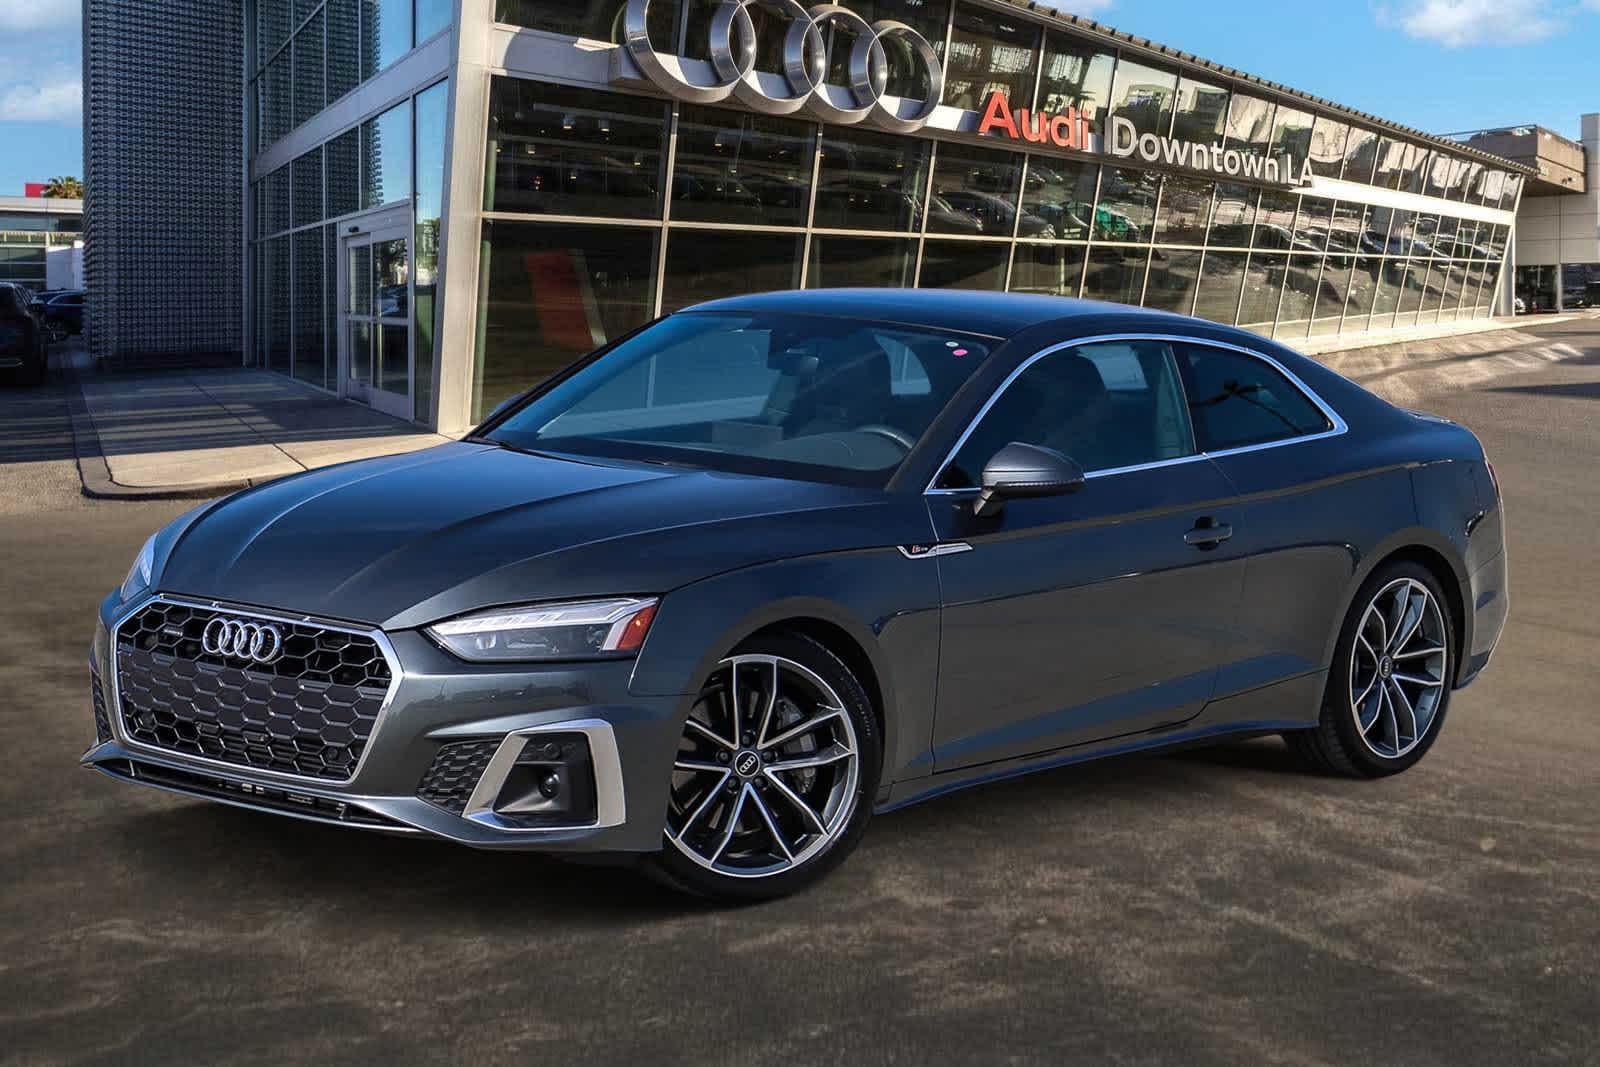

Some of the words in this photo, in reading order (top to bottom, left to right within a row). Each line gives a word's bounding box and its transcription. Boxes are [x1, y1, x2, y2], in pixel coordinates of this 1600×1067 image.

[978, 90, 1089, 150] Audi
[1105, 115, 1279, 182] Downtown
[1286, 153, 1313, 188] LA
